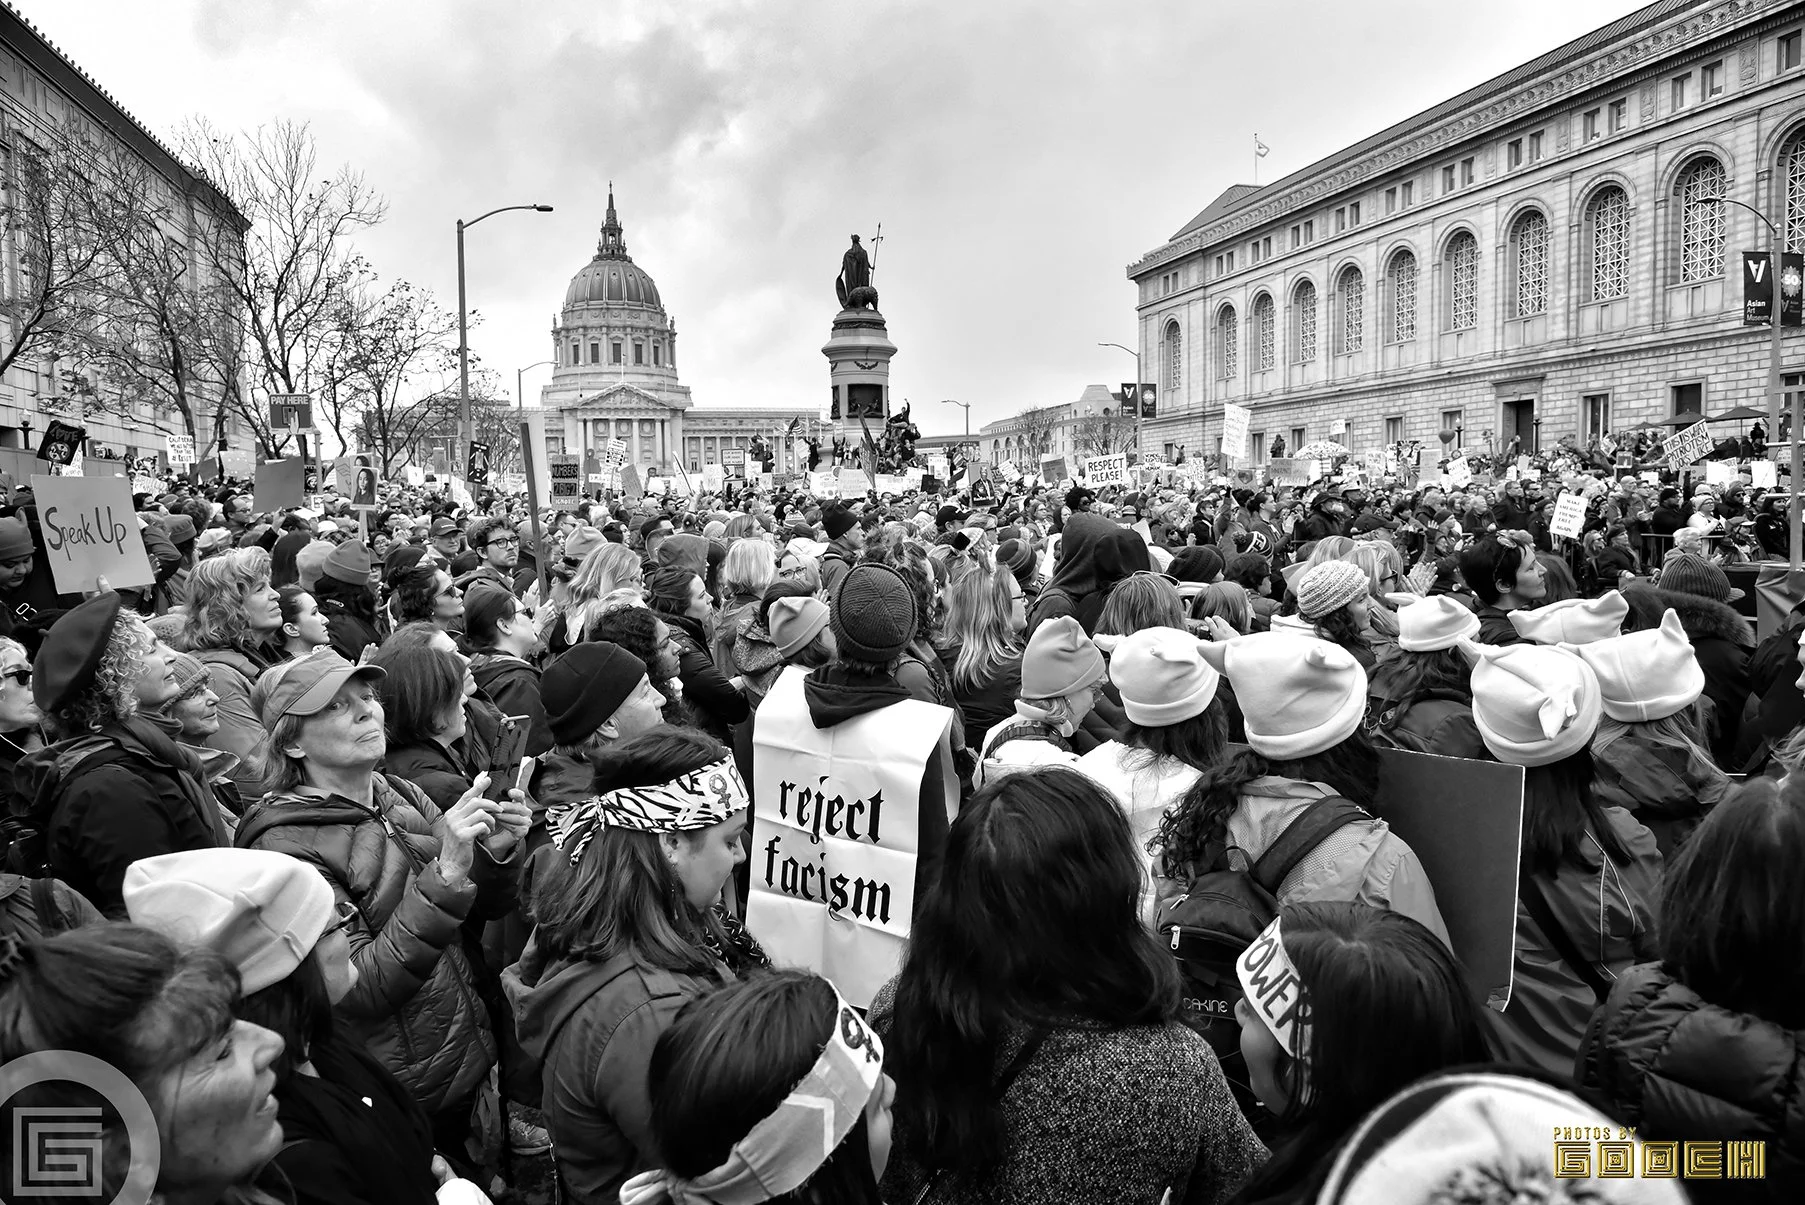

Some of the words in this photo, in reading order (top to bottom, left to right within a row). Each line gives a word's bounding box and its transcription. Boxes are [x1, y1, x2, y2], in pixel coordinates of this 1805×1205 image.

[1784, 274, 1799, 286] 50
[1747, 299, 1766, 307] Asian
[1747, 313, 1770, 321] Museum
[270, 396, 286, 405] PAY
[286, 396, 309, 405] HERE
[1667, 431, 1711, 462] PATRIOTISM
[1692, 440, 1714, 461] LIKE
[551, 464, 578, 479] NUMBERS
[1088, 457, 1125, 473] RESPECT
[1091, 470, 1123, 483] PLEASE!
[45, 506, 97, 561] Speak
[95, 506, 127, 554] Up
[1556, 525, 1572, 533] AGAIN
[779, 775, 885, 845] reject
[764, 835, 891, 925] facism
